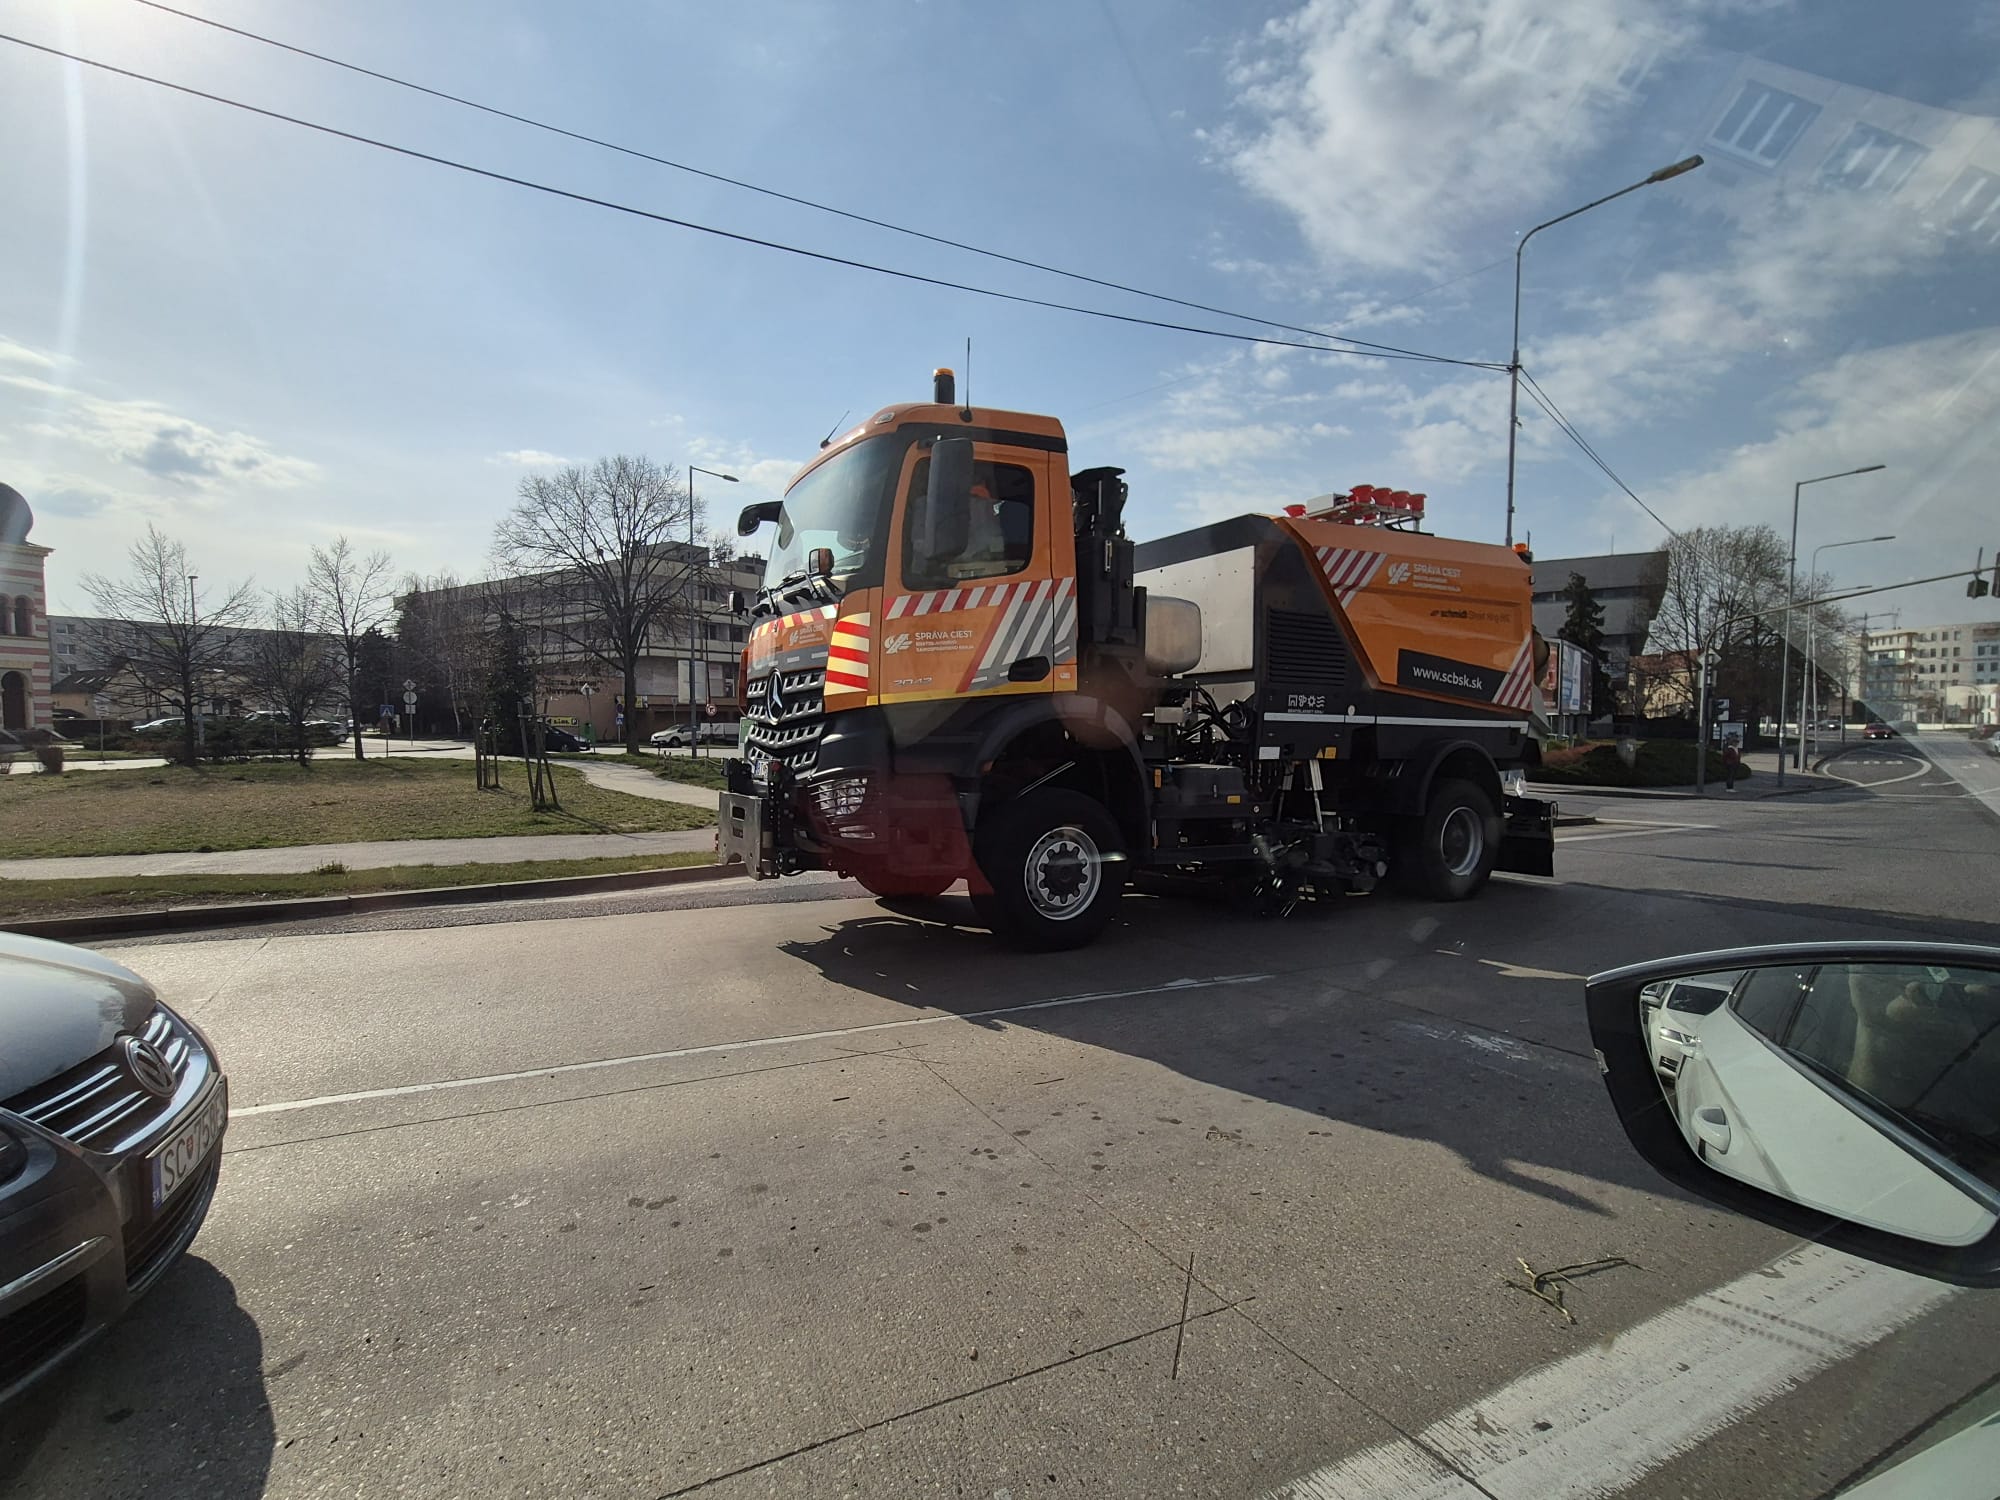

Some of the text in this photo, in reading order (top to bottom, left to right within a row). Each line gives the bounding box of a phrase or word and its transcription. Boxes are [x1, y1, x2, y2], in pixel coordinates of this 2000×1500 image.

[915, 630, 973, 641] SPRÁVA CIEST
[1413, 666, 1483, 690] www.scbsk.sk
[164, 1138, 187, 1192] SC
